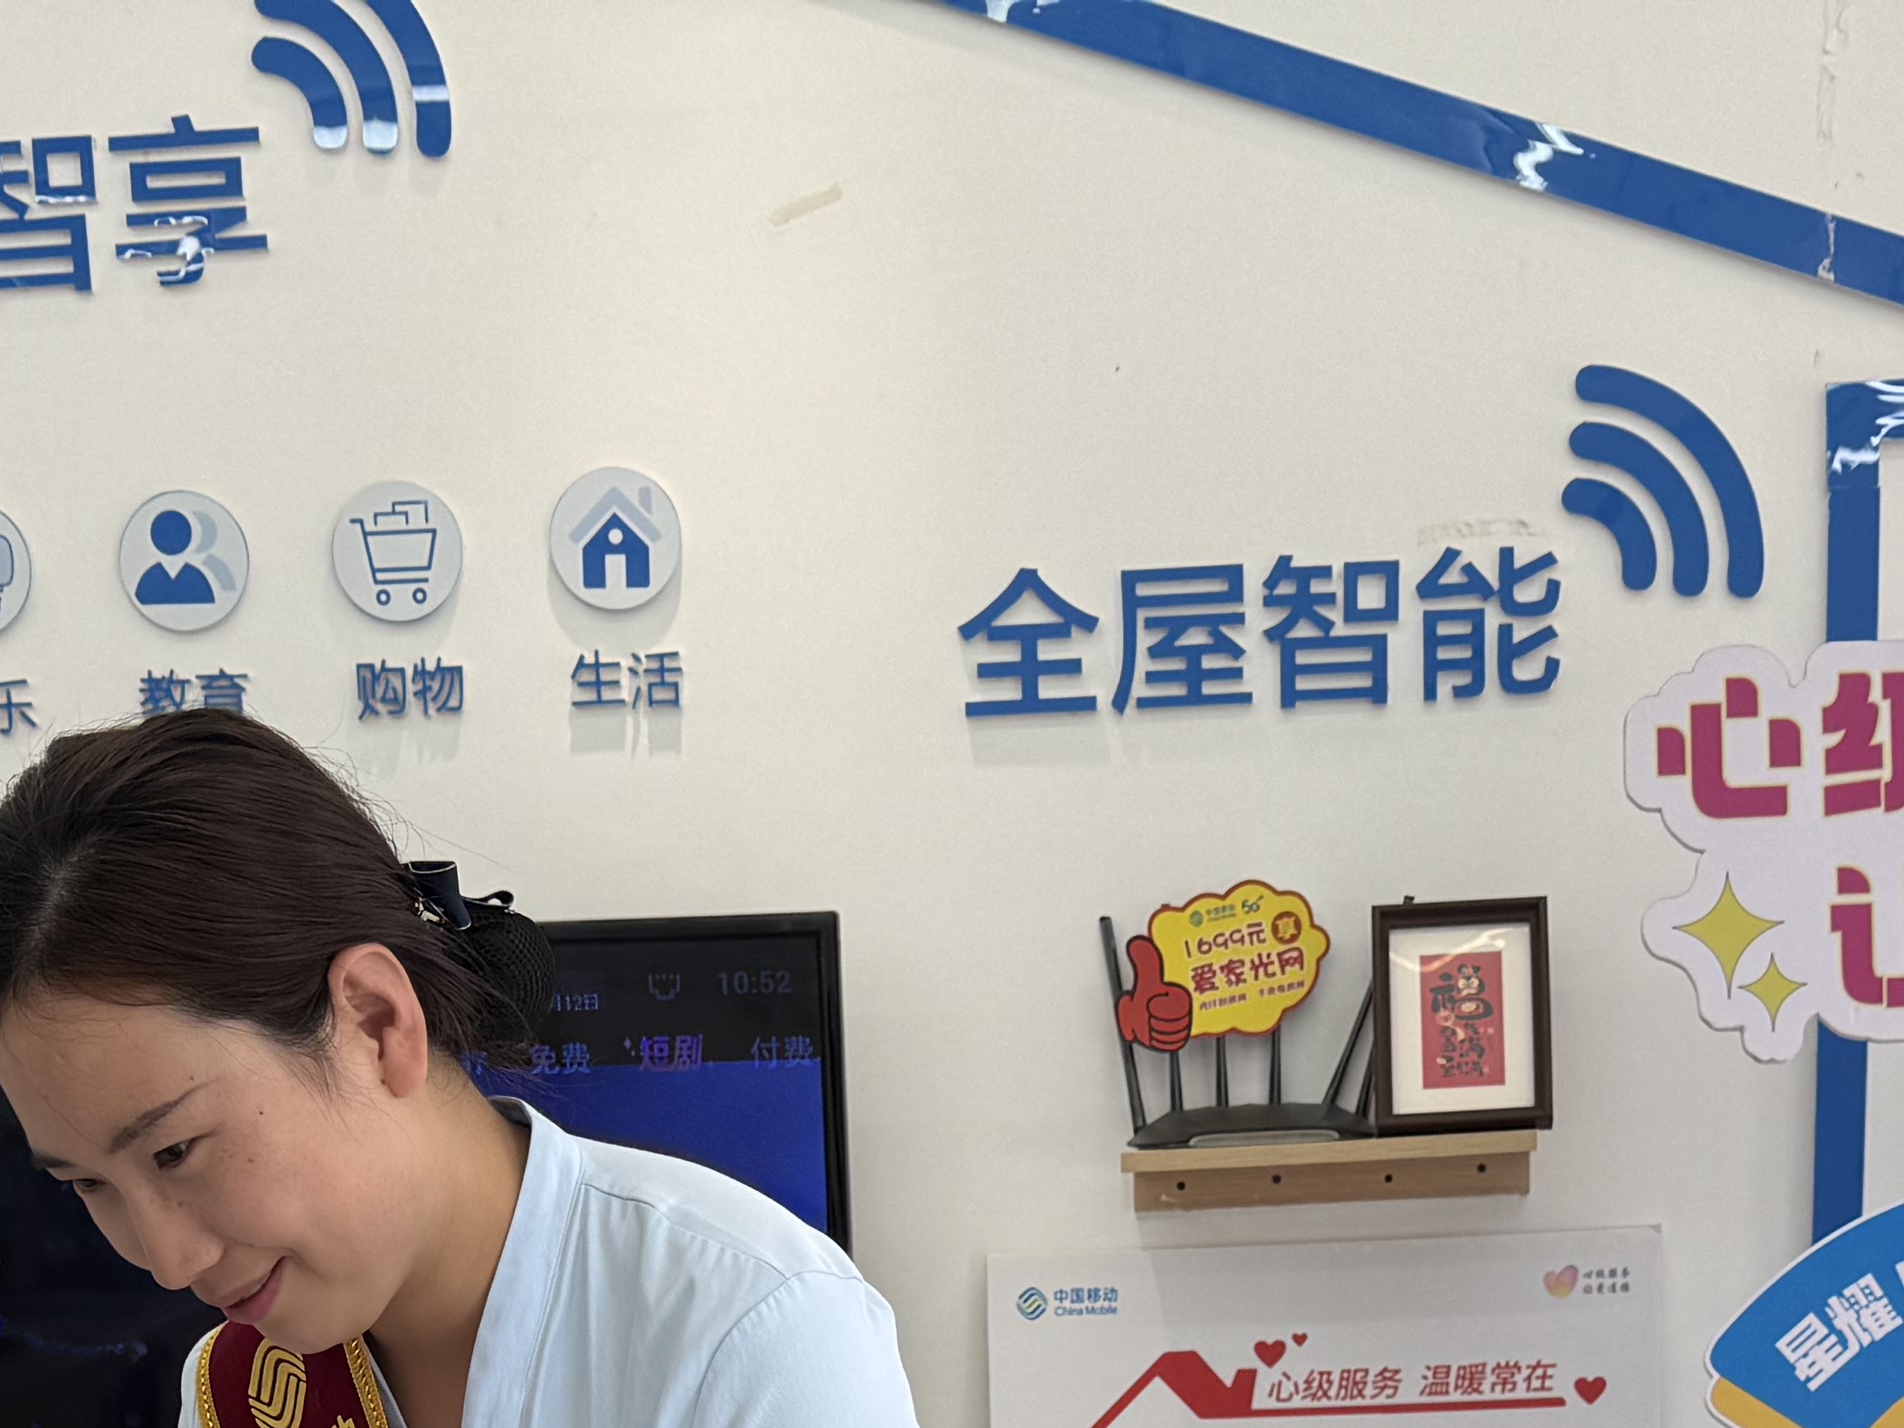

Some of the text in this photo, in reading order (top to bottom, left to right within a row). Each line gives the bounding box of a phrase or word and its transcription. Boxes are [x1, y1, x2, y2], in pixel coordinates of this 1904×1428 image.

[958, 546, 1562, 718] 全屋智能
[140, 669, 249, 718] 教育
[354, 658, 463, 719] 购物
[570, 651, 683, 711] 生活
[1185, 922, 1266, 958] 1699元
[717, 971, 793, 995] 10:52
[529, 1042, 591, 1075] 免费
[638, 1035, 703, 1071] 短剧
[750, 1036, 815, 1069] 付费
[1053, 1286, 1118, 1304] 中国移动
[1054, 1303, 1118, 1317] China Mobile
[1268, 1358, 1557, 1403] 心级服务 温暖常在
